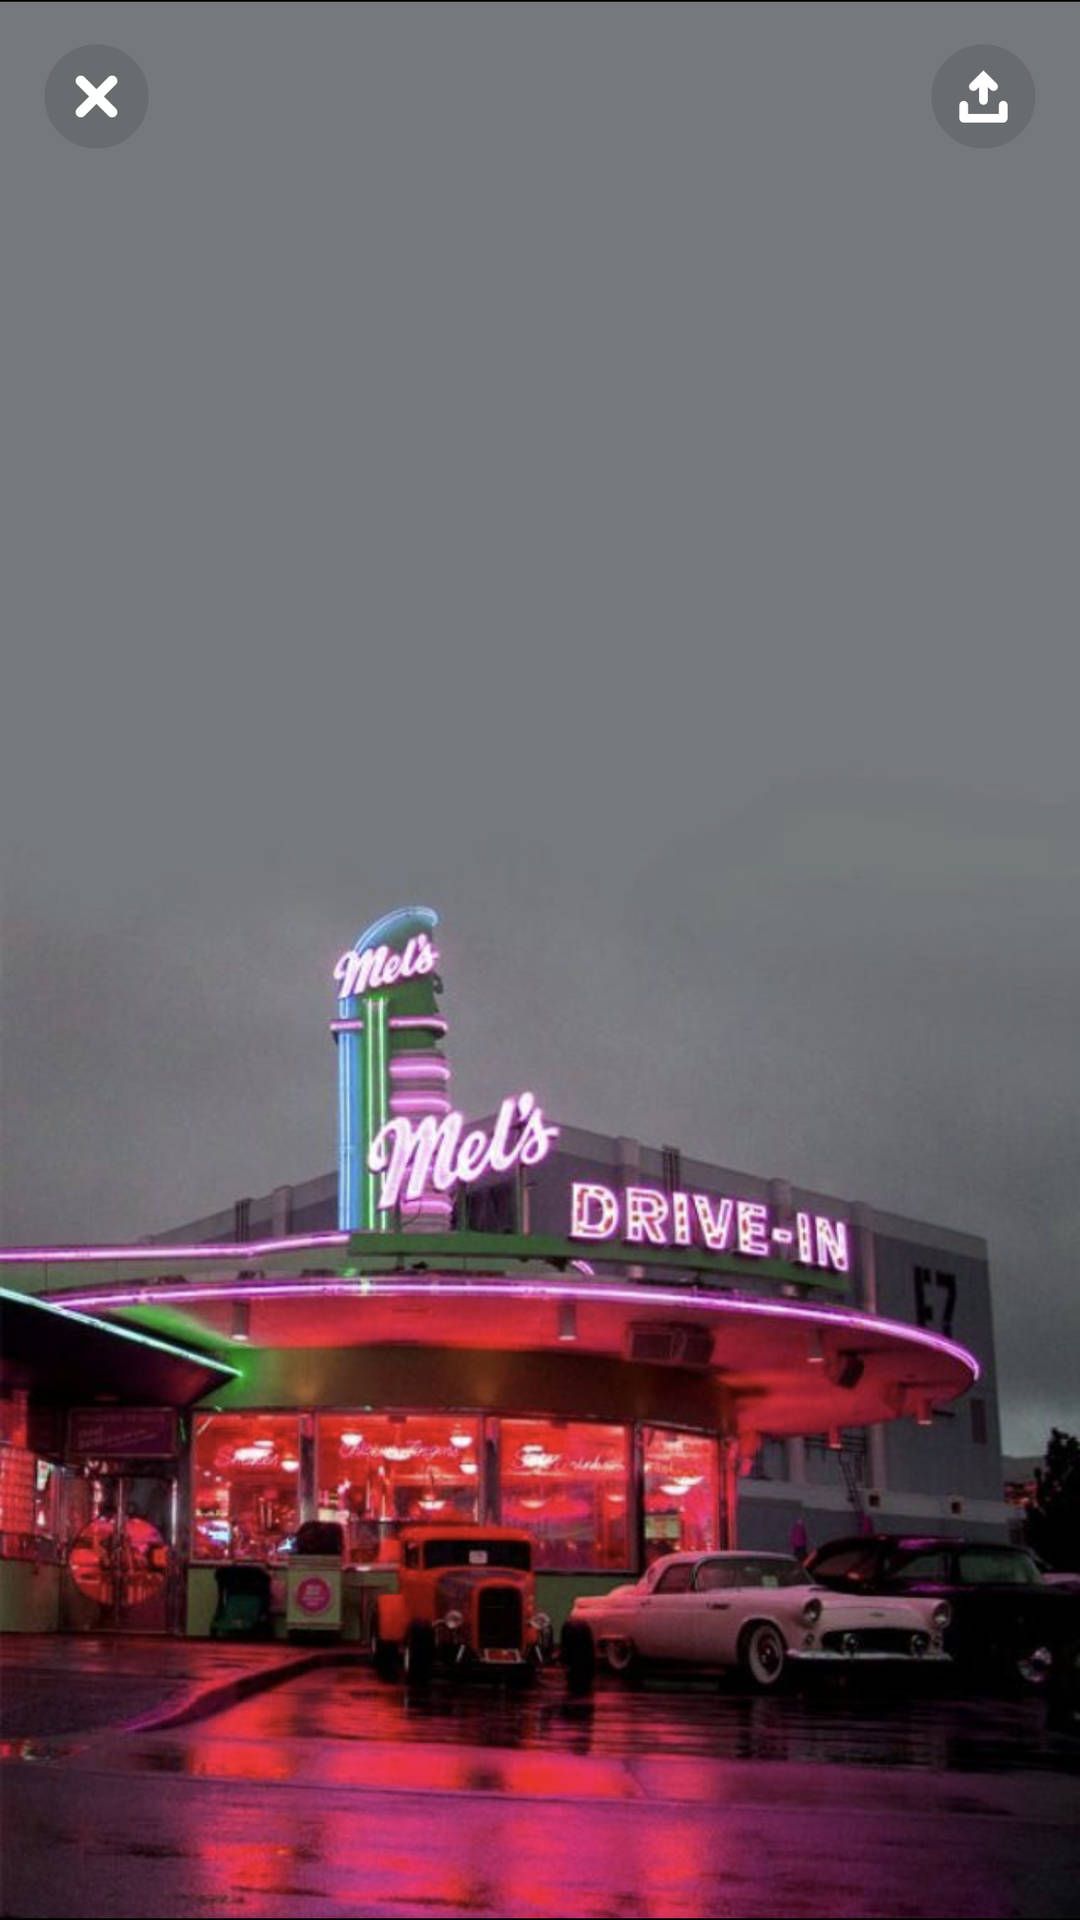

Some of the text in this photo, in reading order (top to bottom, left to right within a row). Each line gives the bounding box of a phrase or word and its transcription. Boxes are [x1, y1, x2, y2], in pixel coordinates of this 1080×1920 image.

[334, 933, 439, 999] Mel's
[367, 1092, 559, 1210] Mel's
[570, 1182, 850, 1272] DRIVE-IN
